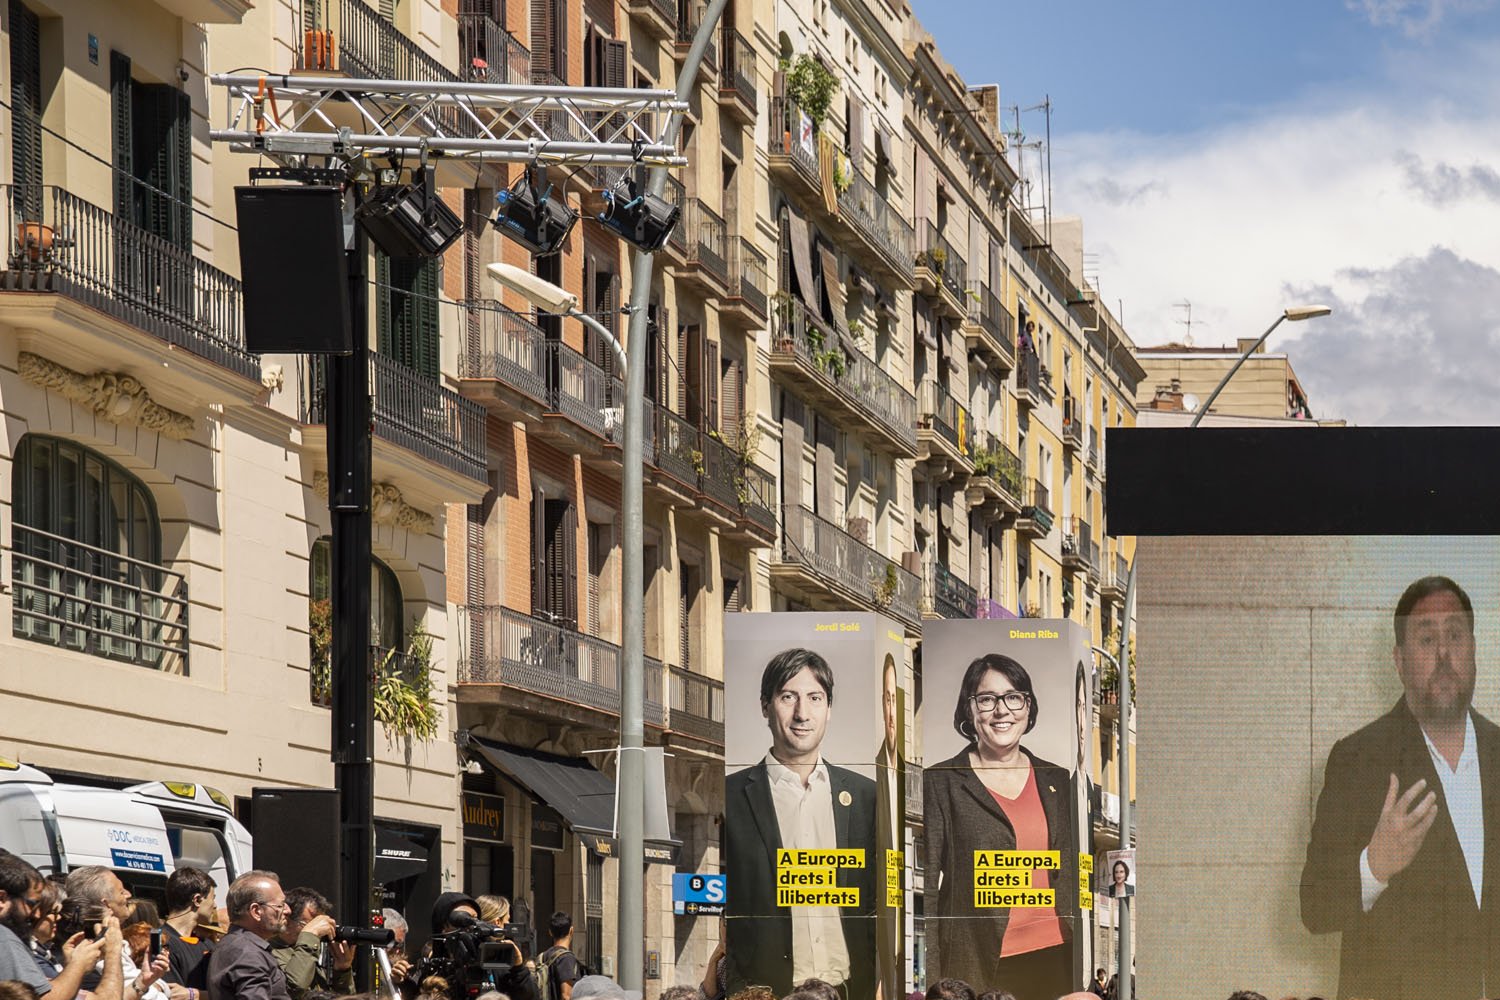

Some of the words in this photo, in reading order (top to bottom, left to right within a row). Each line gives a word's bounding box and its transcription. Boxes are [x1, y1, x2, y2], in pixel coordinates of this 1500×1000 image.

[1009, 630, 1036, 639] Diana
[1038, 630, 1059, 639] Riba
[463, 798, 501, 836] Audrey
[112, 829, 132, 844] DOC
[381, 849, 411, 857] SHURE
[780, 852, 793, 865] A
[797, 852, 863, 868] Europa,
[977, 853, 989, 867] A
[994, 853, 1057, 870] Europa,
[780, 871, 824, 885] drets
[828, 871, 833, 884] i
[977, 872, 1020, 886] drets
[1024, 872, 1029, 885] i
[692, 879, 702, 889] B
[705, 879, 725, 902] S
[780, 890, 857, 904] llibertats
[977, 891, 1052, 905] llibertats
